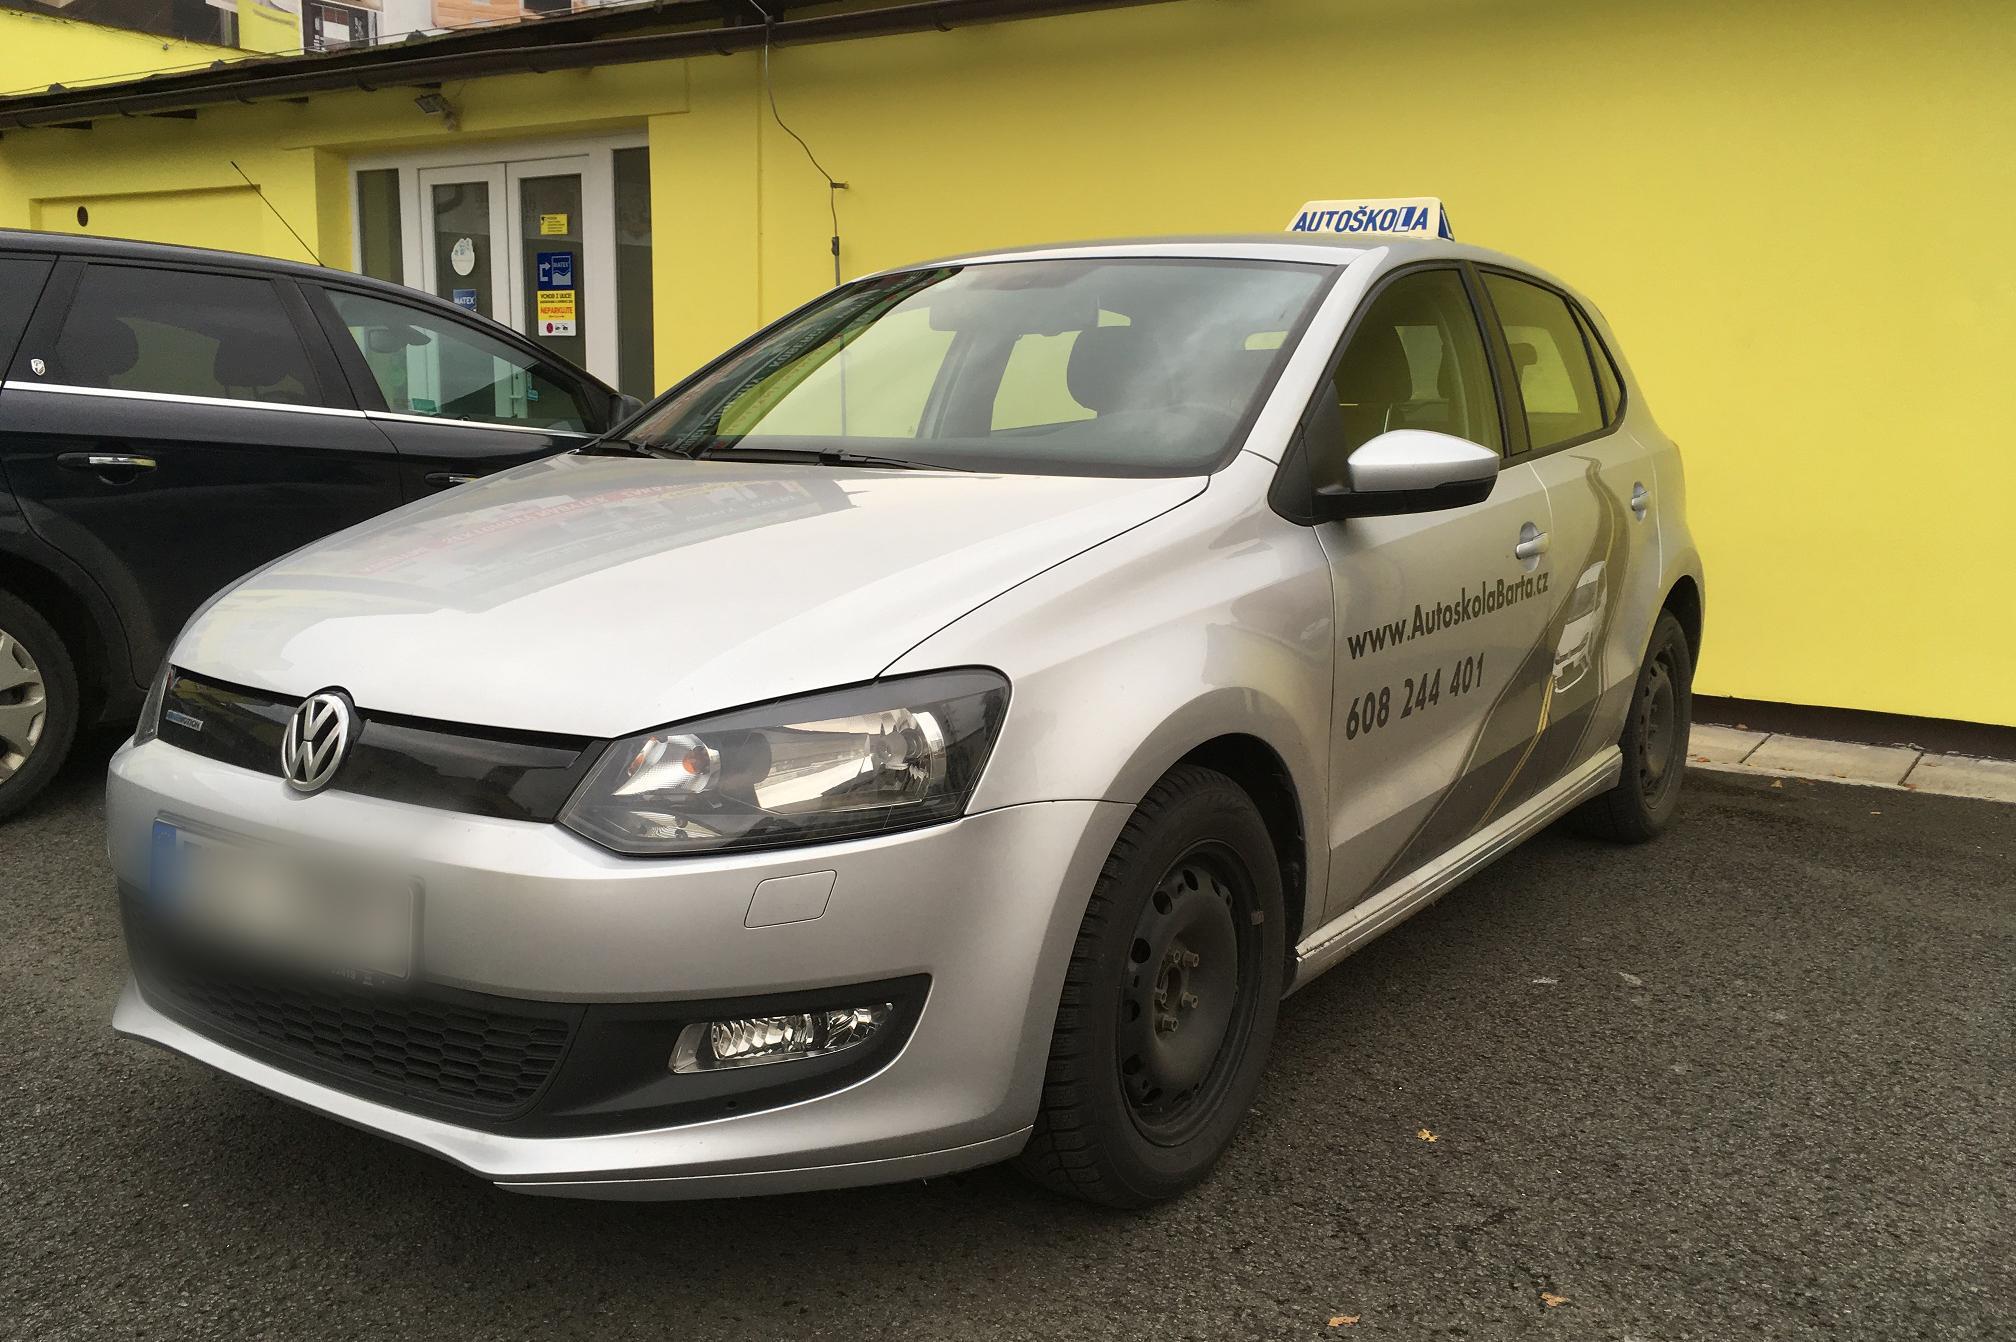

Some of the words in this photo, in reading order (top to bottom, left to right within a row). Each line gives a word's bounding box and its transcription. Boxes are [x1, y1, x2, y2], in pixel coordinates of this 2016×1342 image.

[1292, 205, 1429, 233] AUTOŠKOLA
[454, 296, 475, 305] MATEX
[1346, 571, 1549, 660] www.AutoskolaBarta.cz
[1345, 686, 1391, 741] 608
[1400, 667, 1441, 720] 244
[1449, 652, 1484, 697] 401
